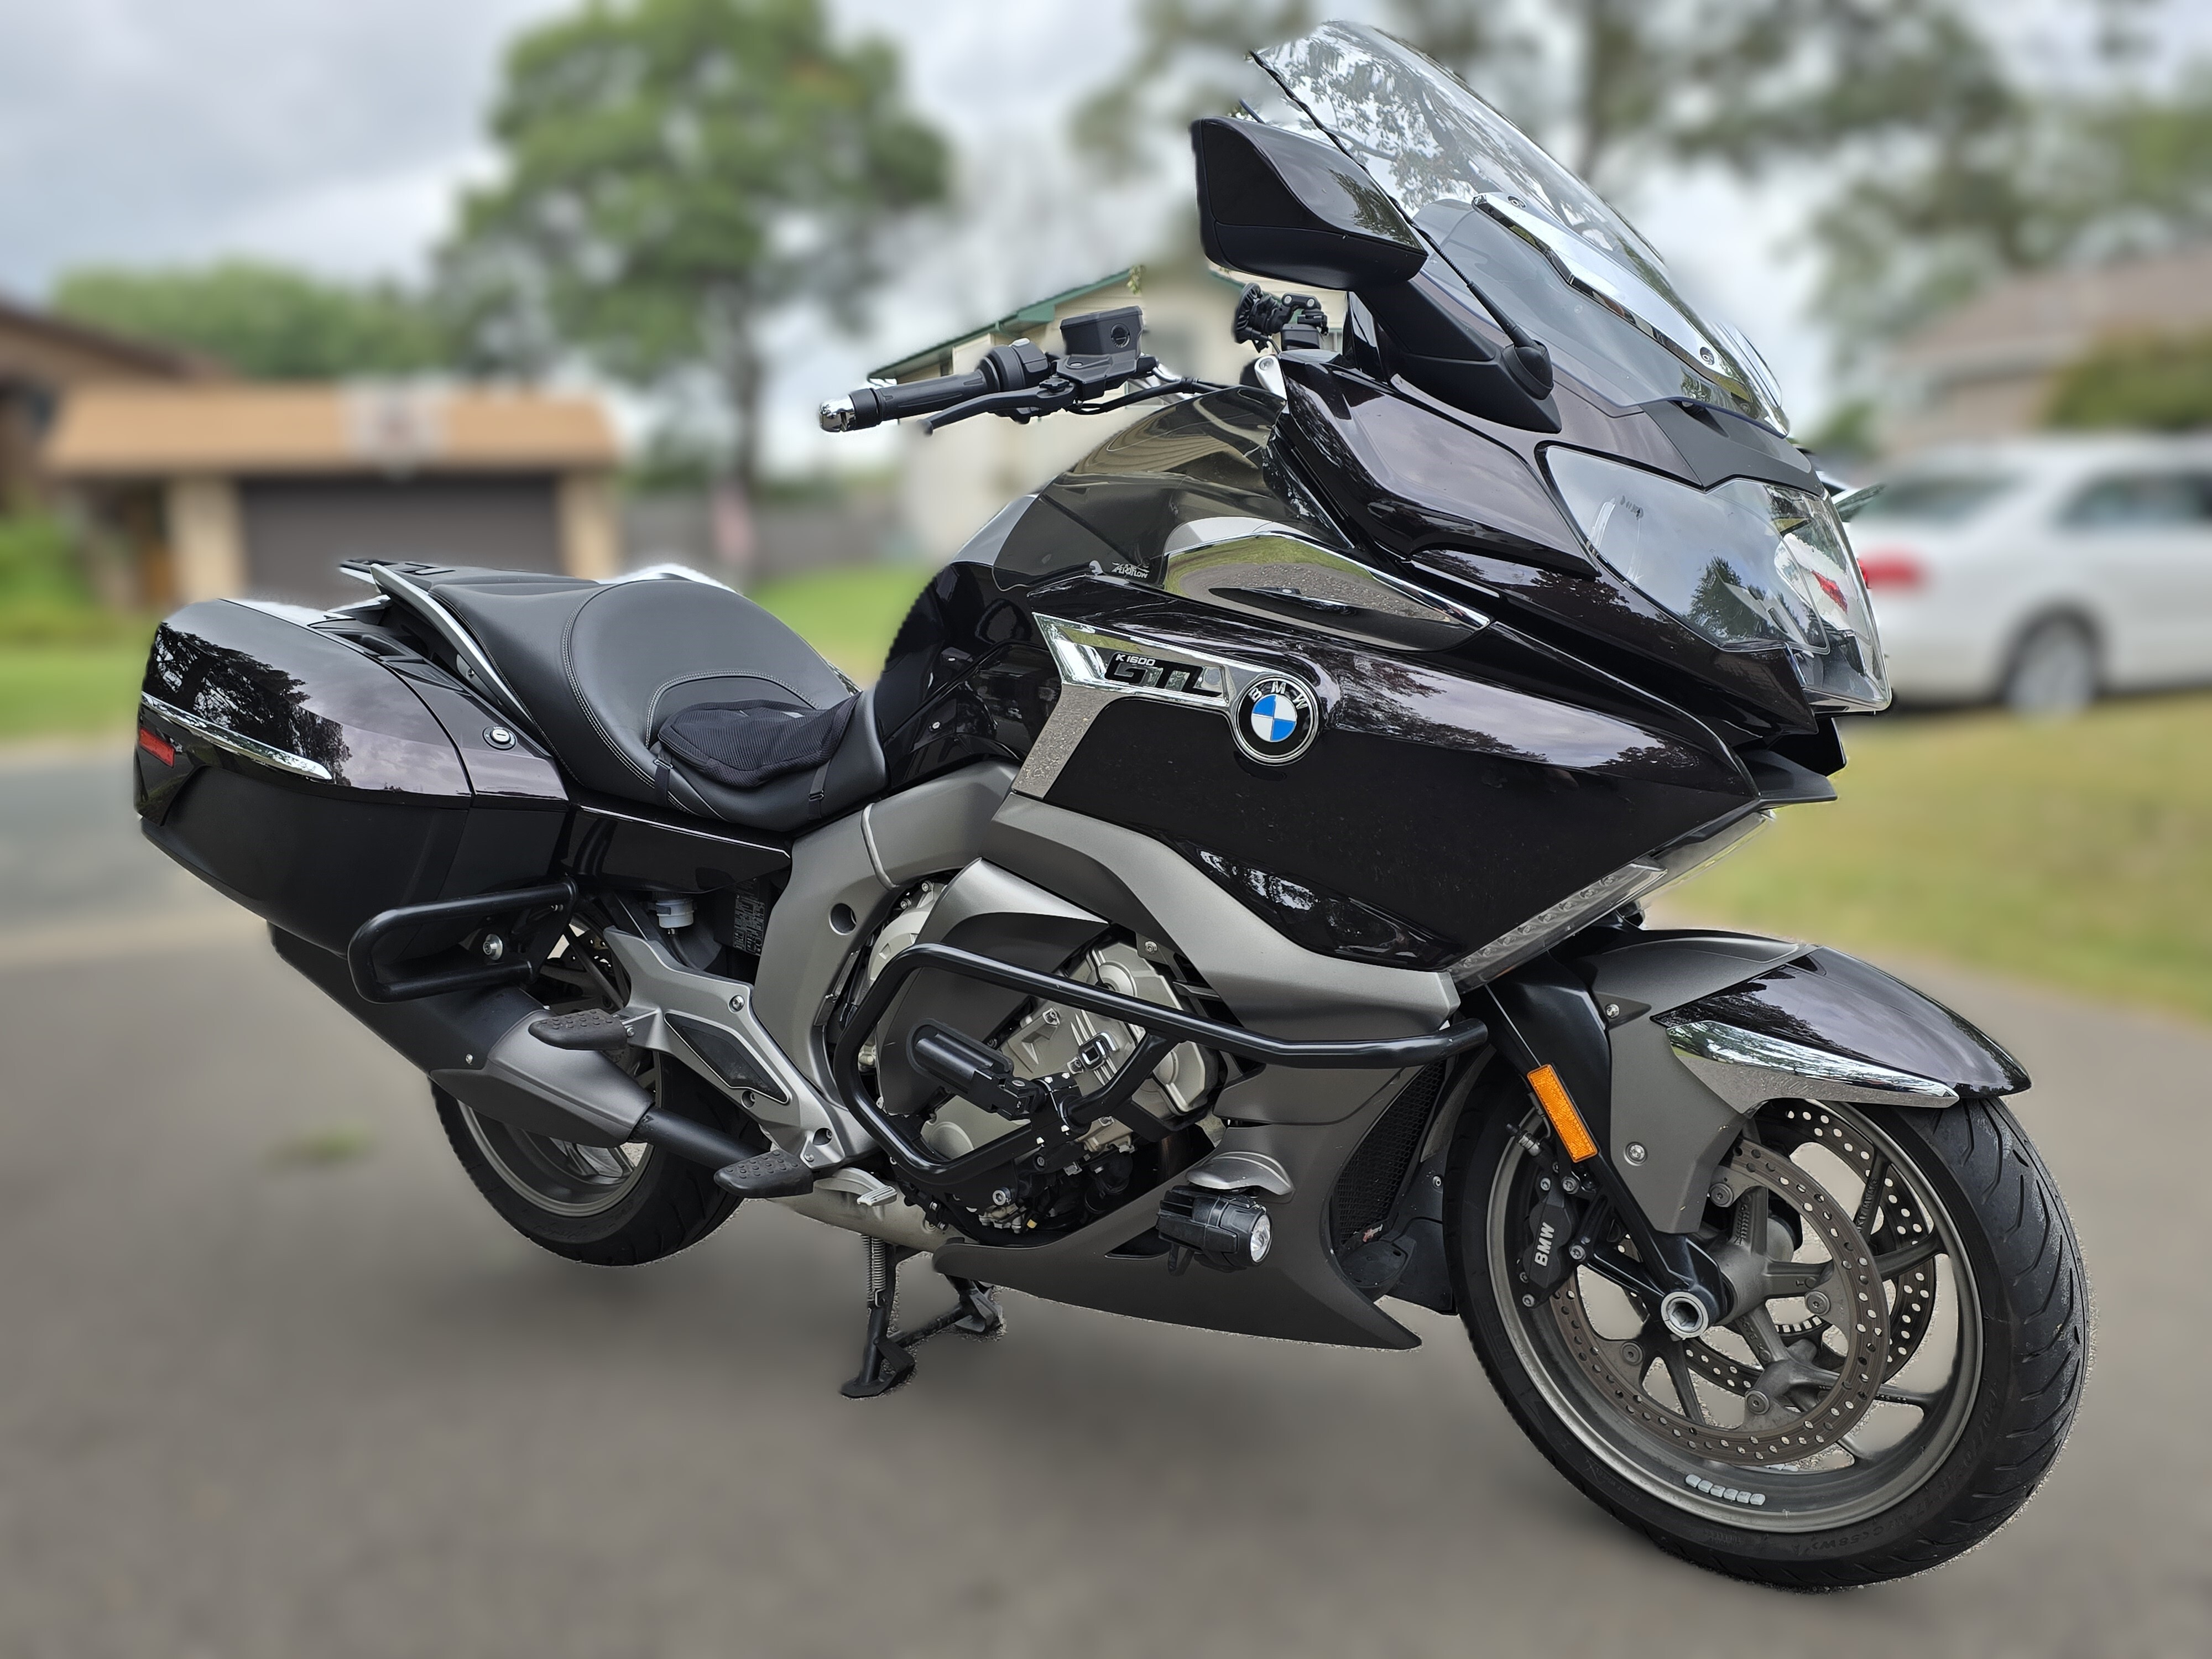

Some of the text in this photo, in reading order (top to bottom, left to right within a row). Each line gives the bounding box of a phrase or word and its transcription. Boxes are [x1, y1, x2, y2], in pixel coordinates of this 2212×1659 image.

[1104, 652, 1222, 697] GTL
[1115, 654, 1156, 666] K 1600
[1248, 681, 1308, 709] BMW
[1534, 1222, 1554, 1266] BMW
